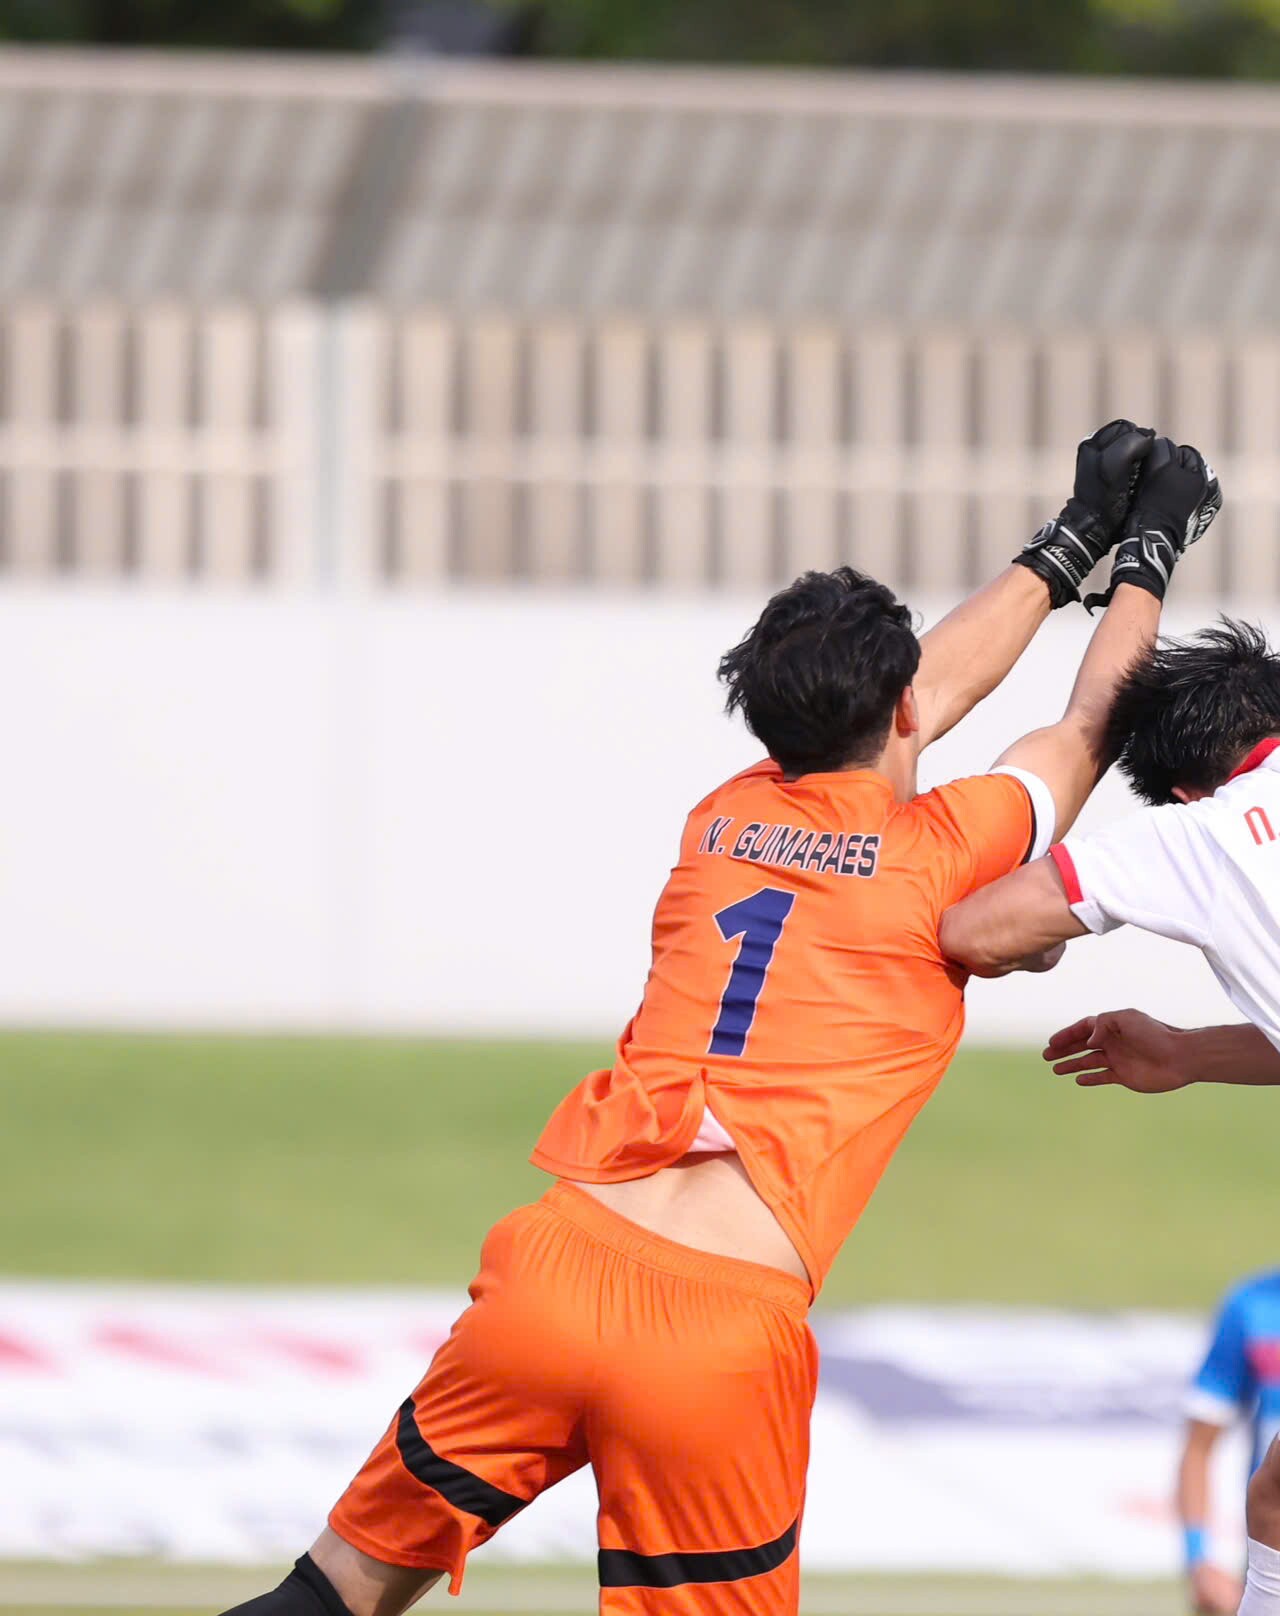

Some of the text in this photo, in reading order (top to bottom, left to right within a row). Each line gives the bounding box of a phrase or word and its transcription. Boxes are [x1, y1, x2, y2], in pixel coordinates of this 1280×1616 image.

[698, 815, 880, 878] N. GUIMARAES
[706, 886, 797, 1057] 1
